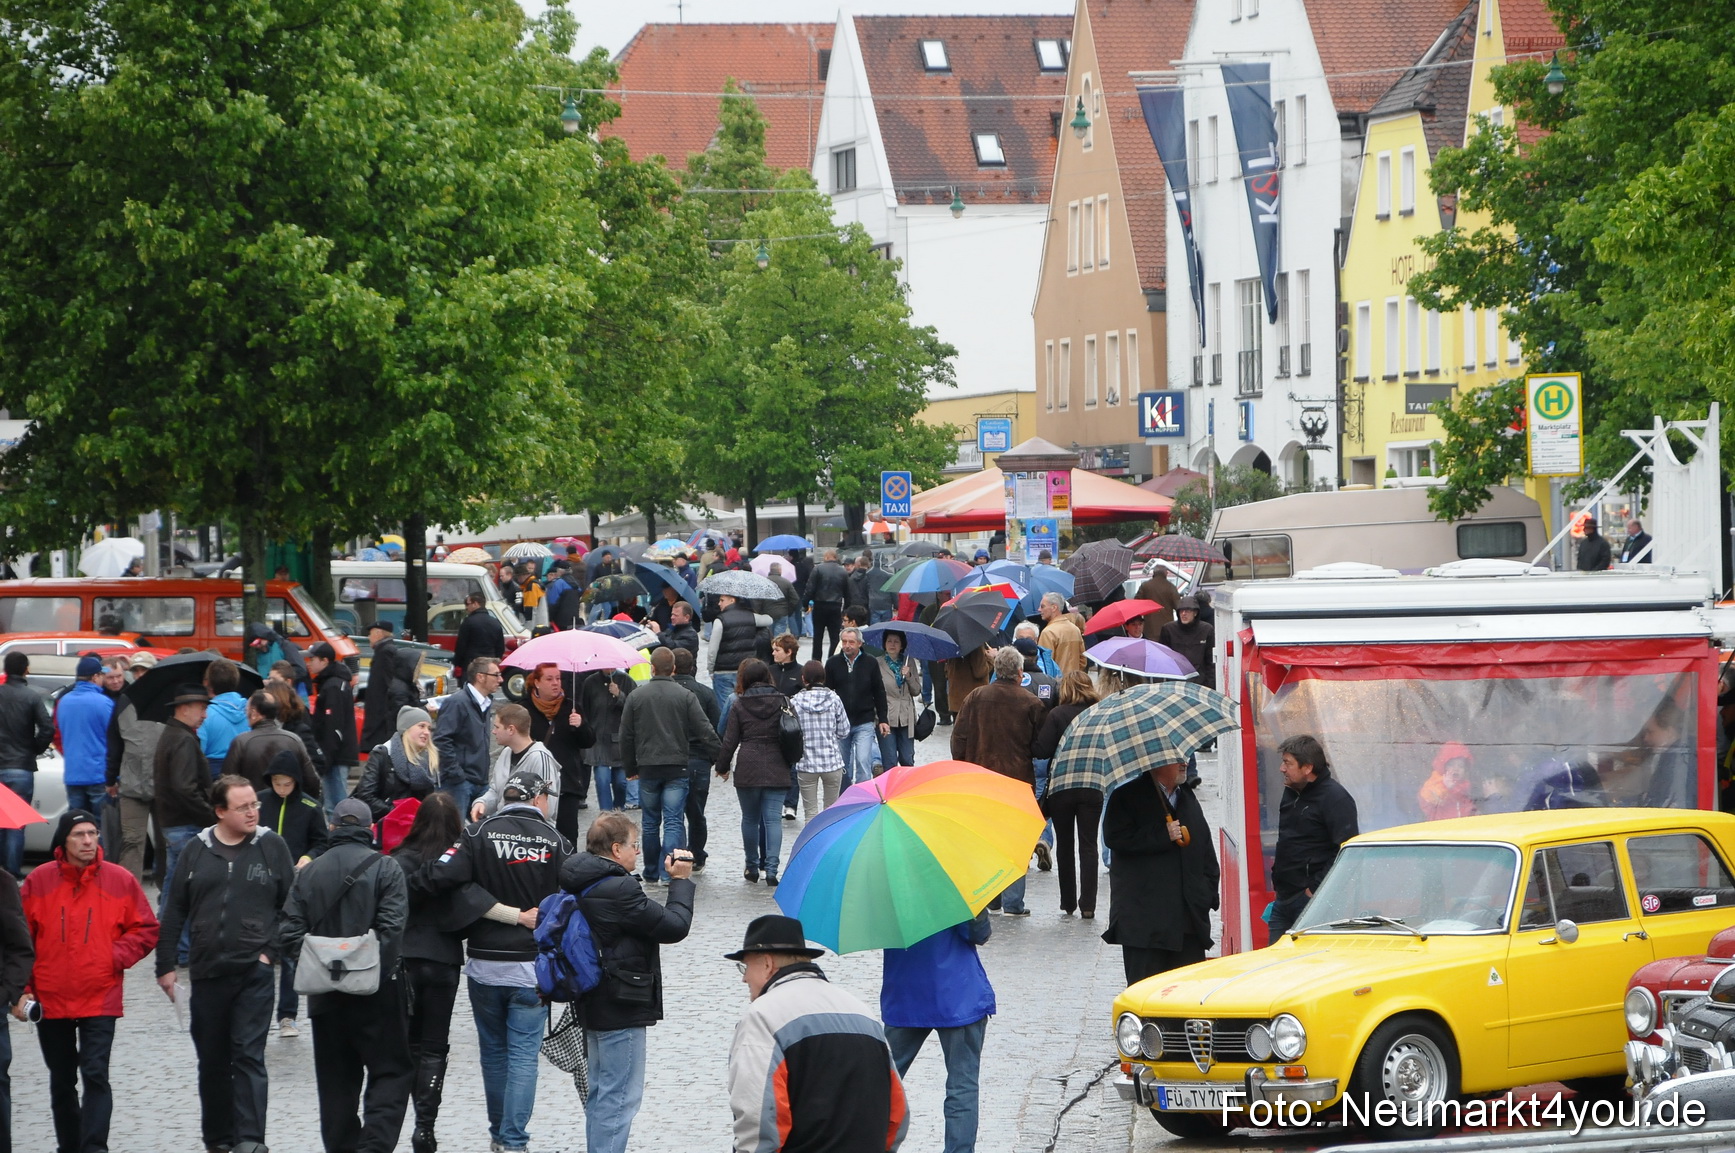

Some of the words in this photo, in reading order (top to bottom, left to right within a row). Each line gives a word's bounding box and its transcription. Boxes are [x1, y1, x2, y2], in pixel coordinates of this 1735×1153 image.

[1390, 411, 1426, 434] Restaurant
[1538, 424, 1572, 435] Marktplatz
[884, 502, 909, 513] TAXI
[487, 831, 558, 847] Mercedes-Benz
[492, 840, 549, 863] West
[1644, 896, 1659, 910] STP
[1166, 1087, 1183, 1107] FÜ
